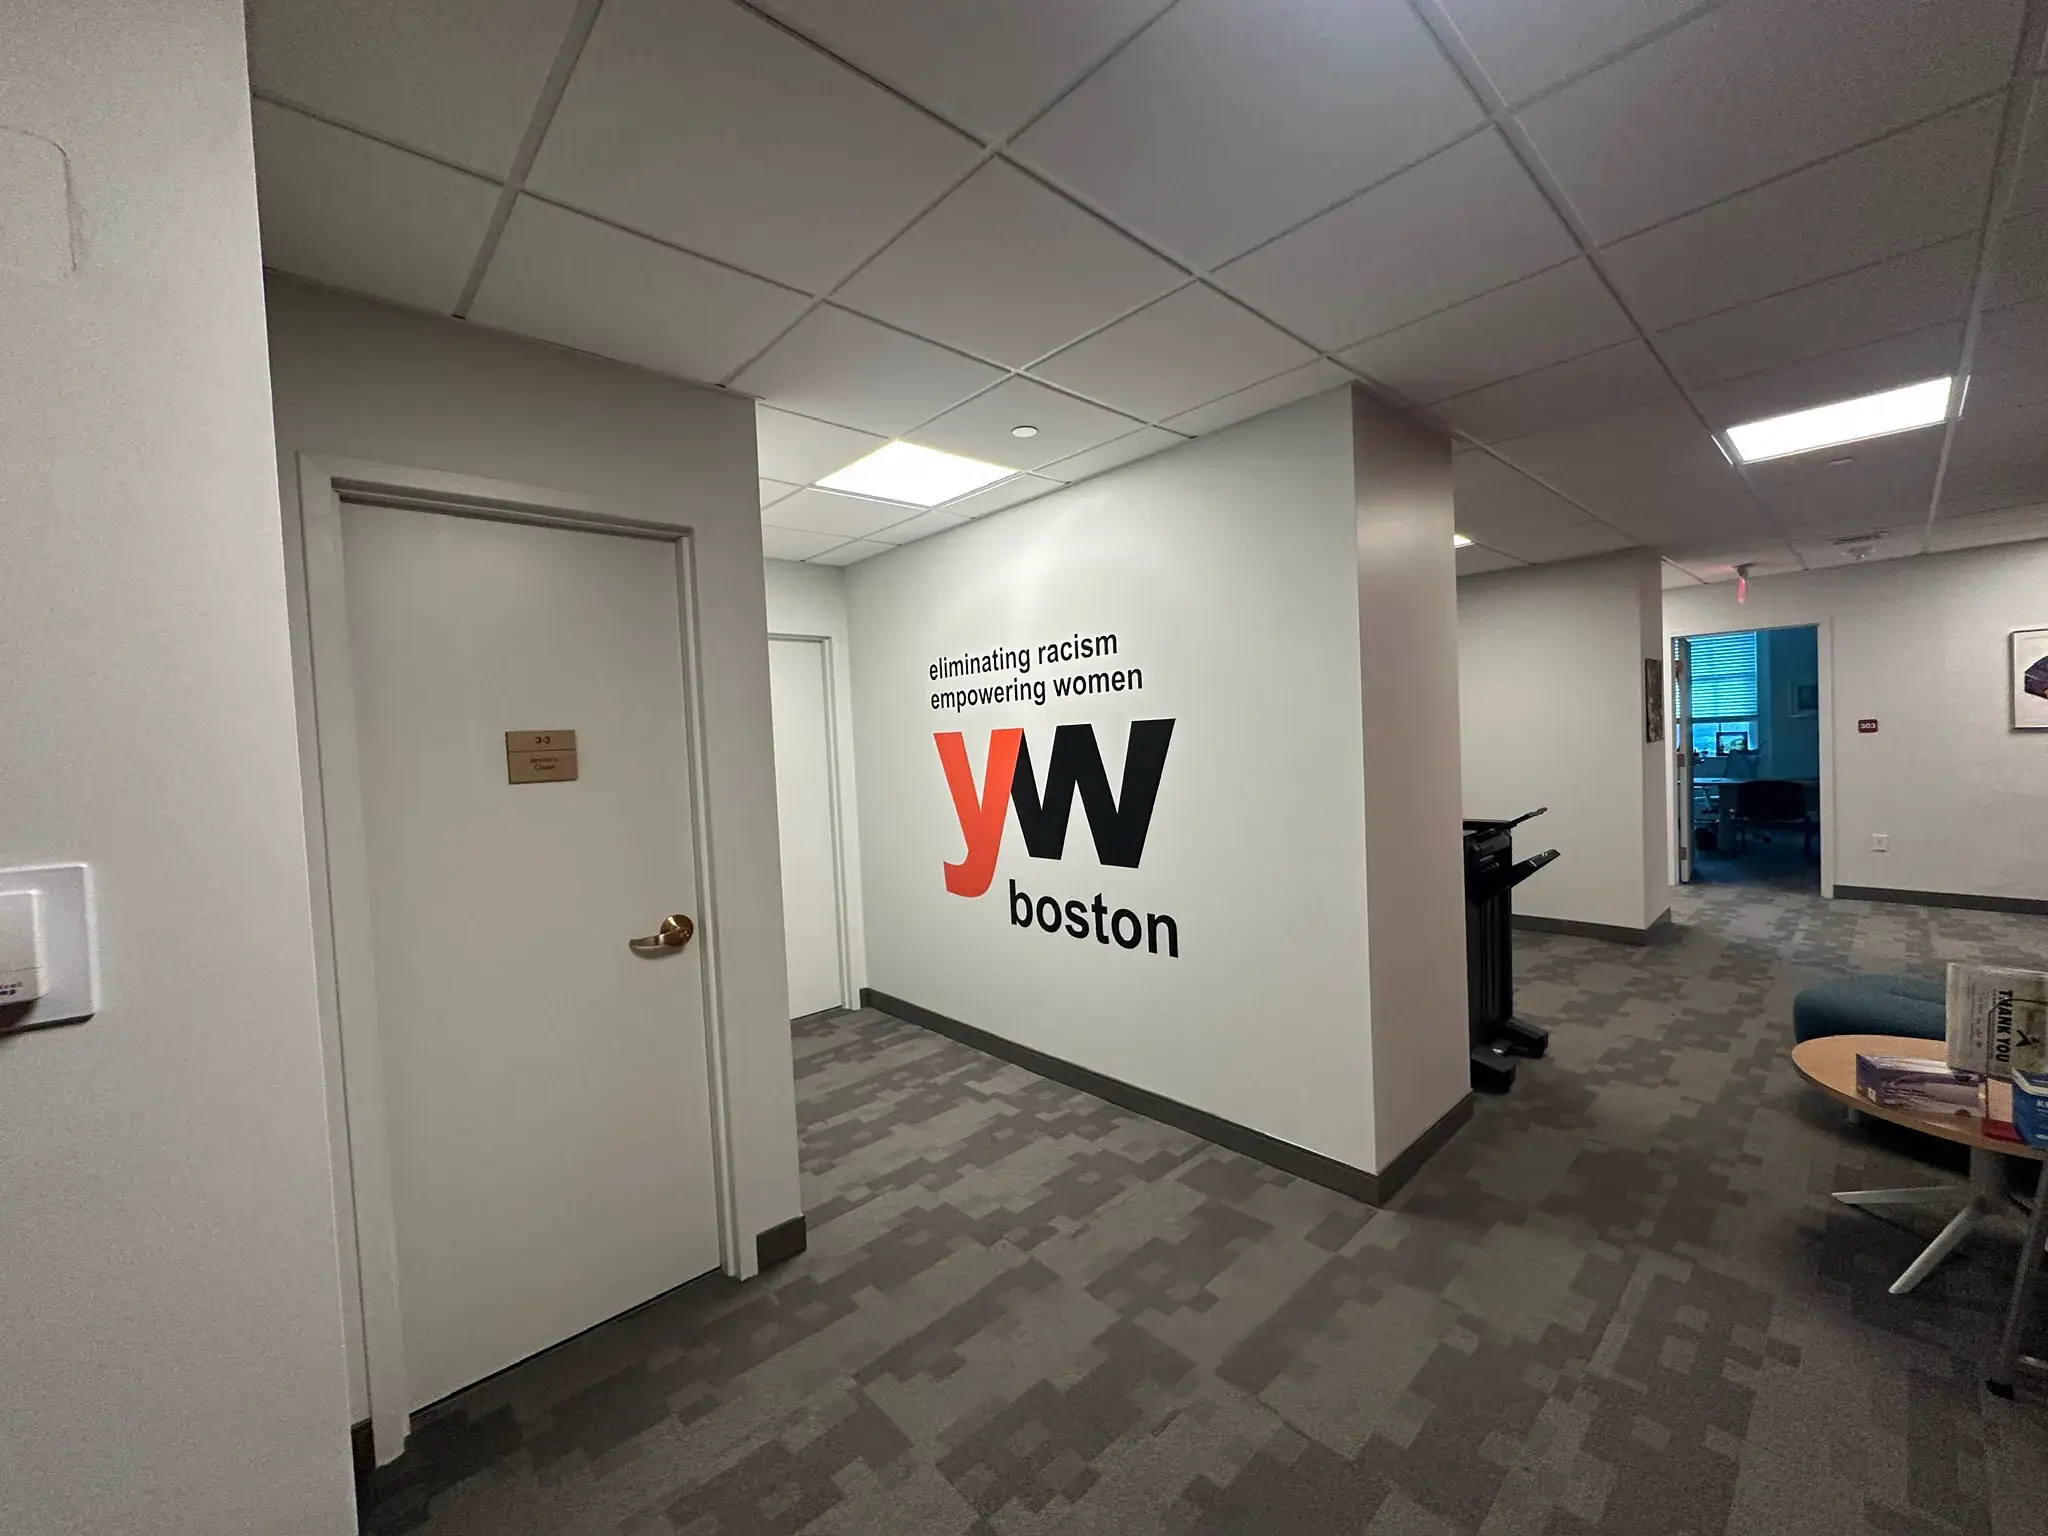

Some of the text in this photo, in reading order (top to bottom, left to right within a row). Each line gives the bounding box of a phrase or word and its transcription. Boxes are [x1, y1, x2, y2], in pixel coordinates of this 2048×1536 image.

[929, 633, 1118, 681] eliminating racism
[930, 668, 1143, 713] empowering women
[1009, 878, 1179, 959] boston
[1996, 990, 2014, 1063] THANK YOU
